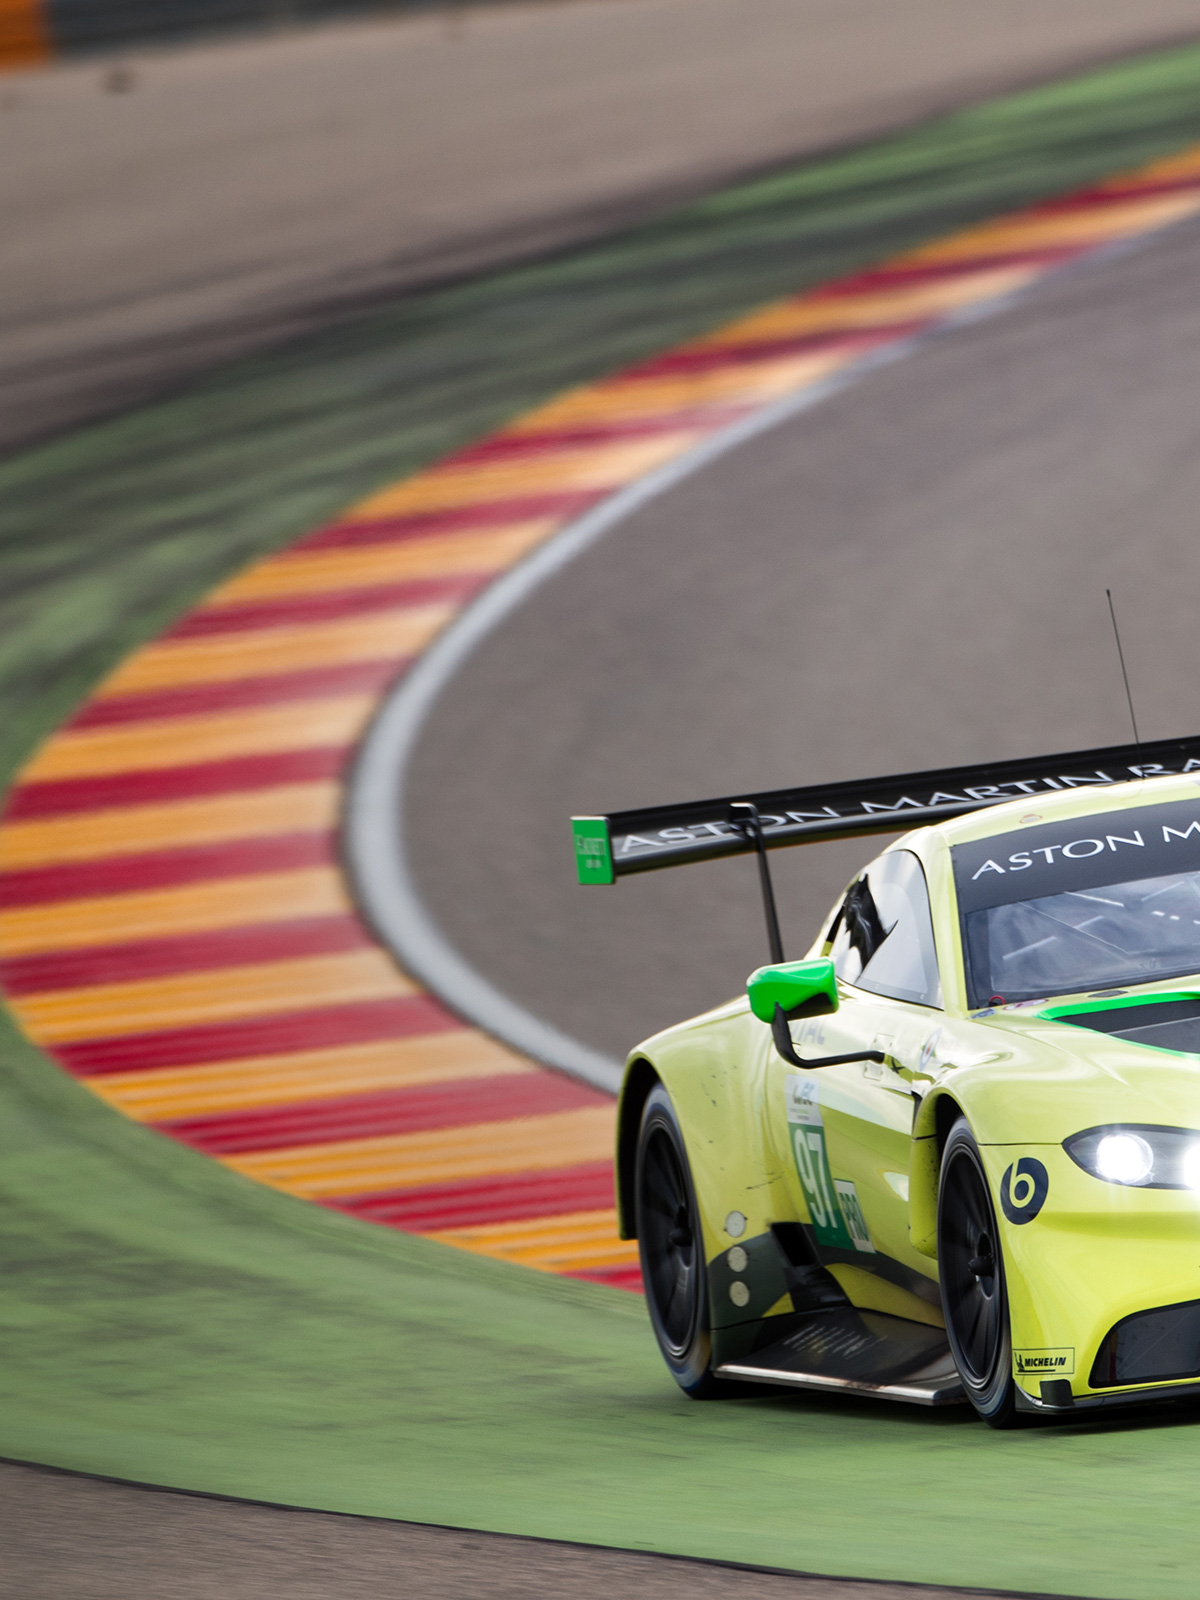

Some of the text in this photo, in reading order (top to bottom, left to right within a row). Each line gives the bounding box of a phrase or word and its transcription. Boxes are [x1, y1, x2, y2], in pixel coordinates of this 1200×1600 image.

[621, 806, 842, 853] ASTON
[861, 771, 1114, 814] MARTIN
[971, 830, 1145, 880] ASTON
[794, 1129, 838, 1229] 97
[1024, 1357, 1067, 1367] MICHELIN
